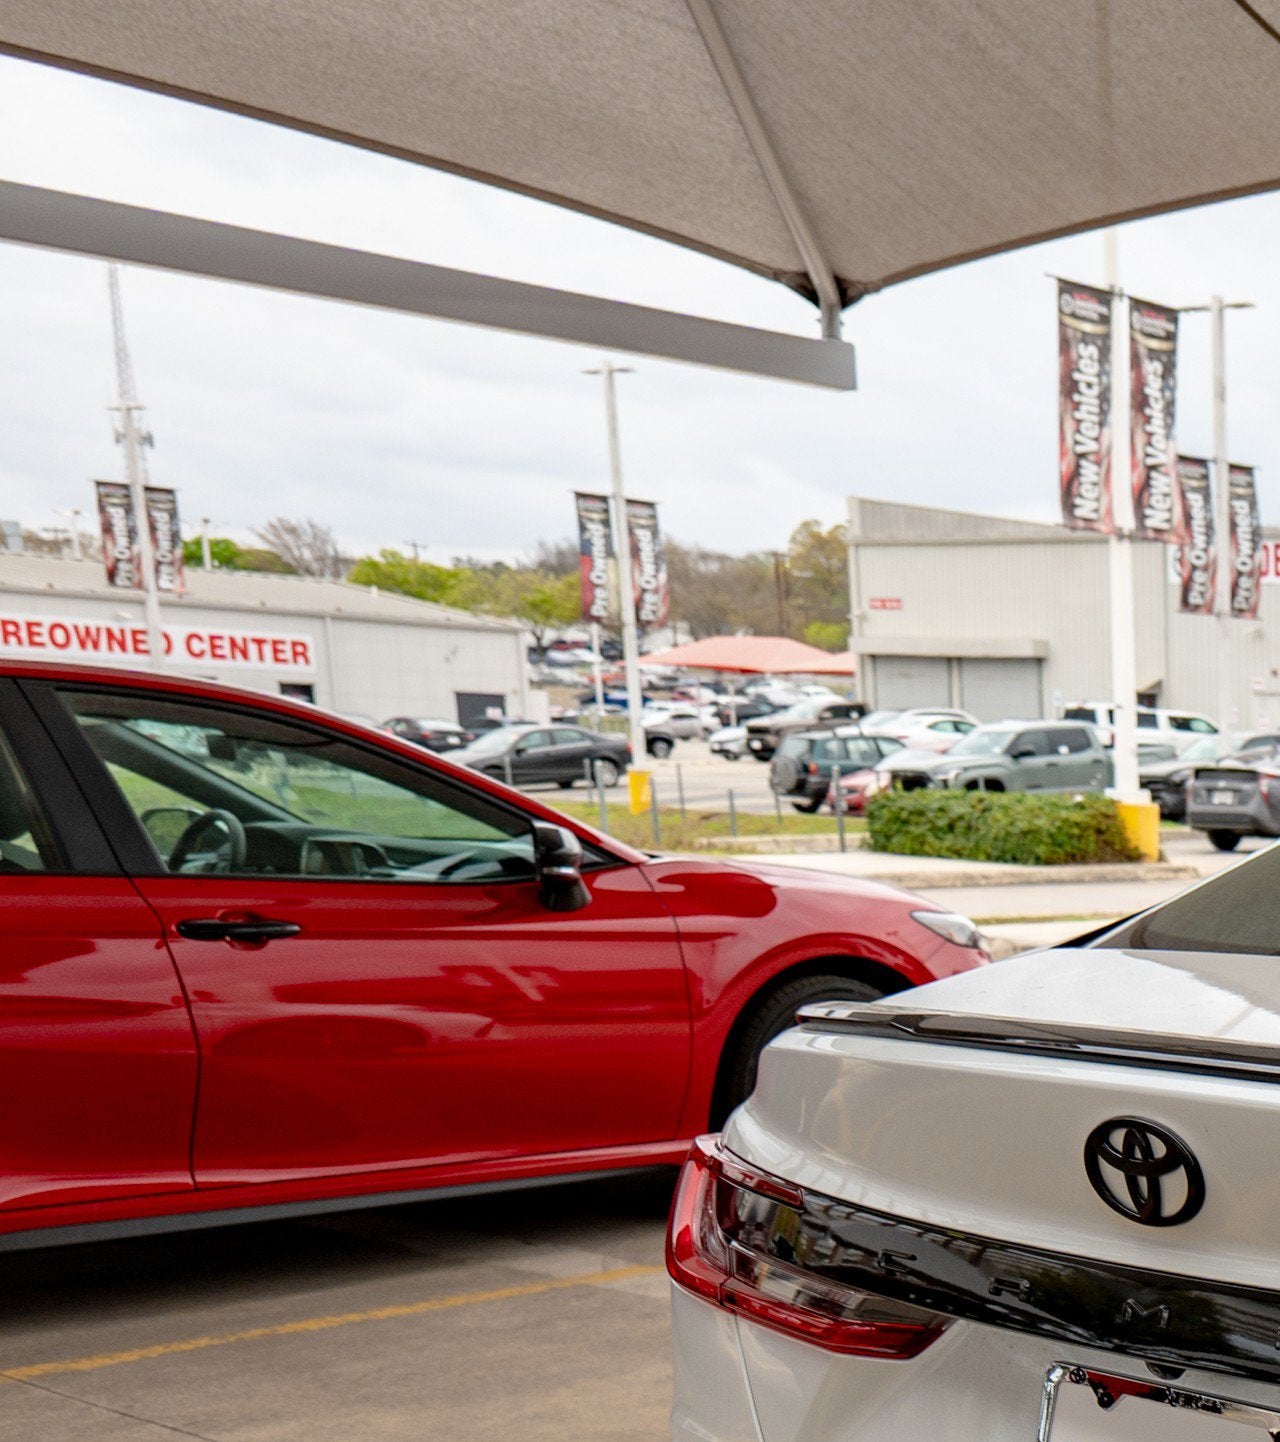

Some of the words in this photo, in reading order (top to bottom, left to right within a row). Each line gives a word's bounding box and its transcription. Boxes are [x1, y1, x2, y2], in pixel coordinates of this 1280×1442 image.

[1072, 342, 1100, 455] Vehicles
[1073, 457, 1100, 521] New
[1143, 469, 1173, 531] New
[1186, 493, 1208, 567] Owned
[1231, 500, 1253, 573] Owned
[1187, 569, 1209, 606] Pre
[1231, 575, 1254, 611] Pre
[185, 632, 311, 666] CENTER
